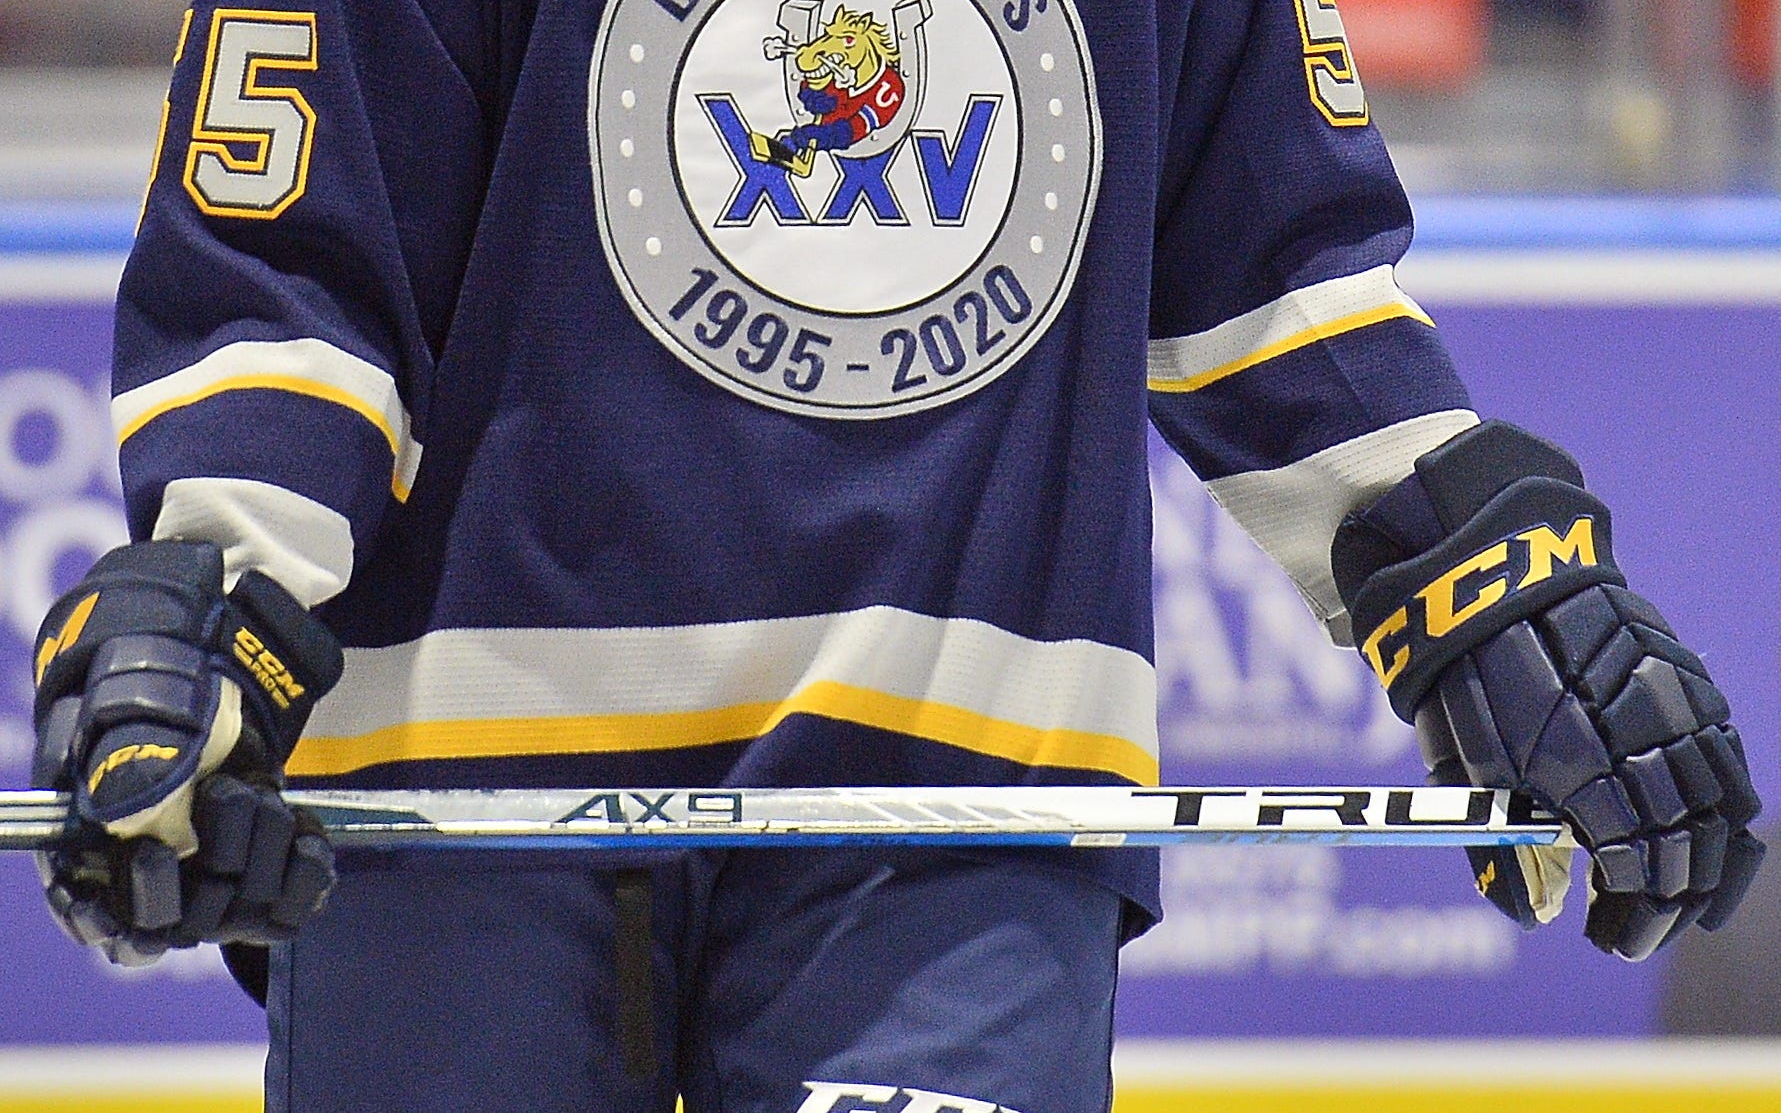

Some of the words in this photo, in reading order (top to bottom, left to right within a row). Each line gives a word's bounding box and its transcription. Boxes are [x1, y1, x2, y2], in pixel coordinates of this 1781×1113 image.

[694, 93, 1004, 228] XXV
[1362, 518, 1598, 691] CCM
[235, 627, 305, 700] CCM
[554, 792, 742, 823] AX9
